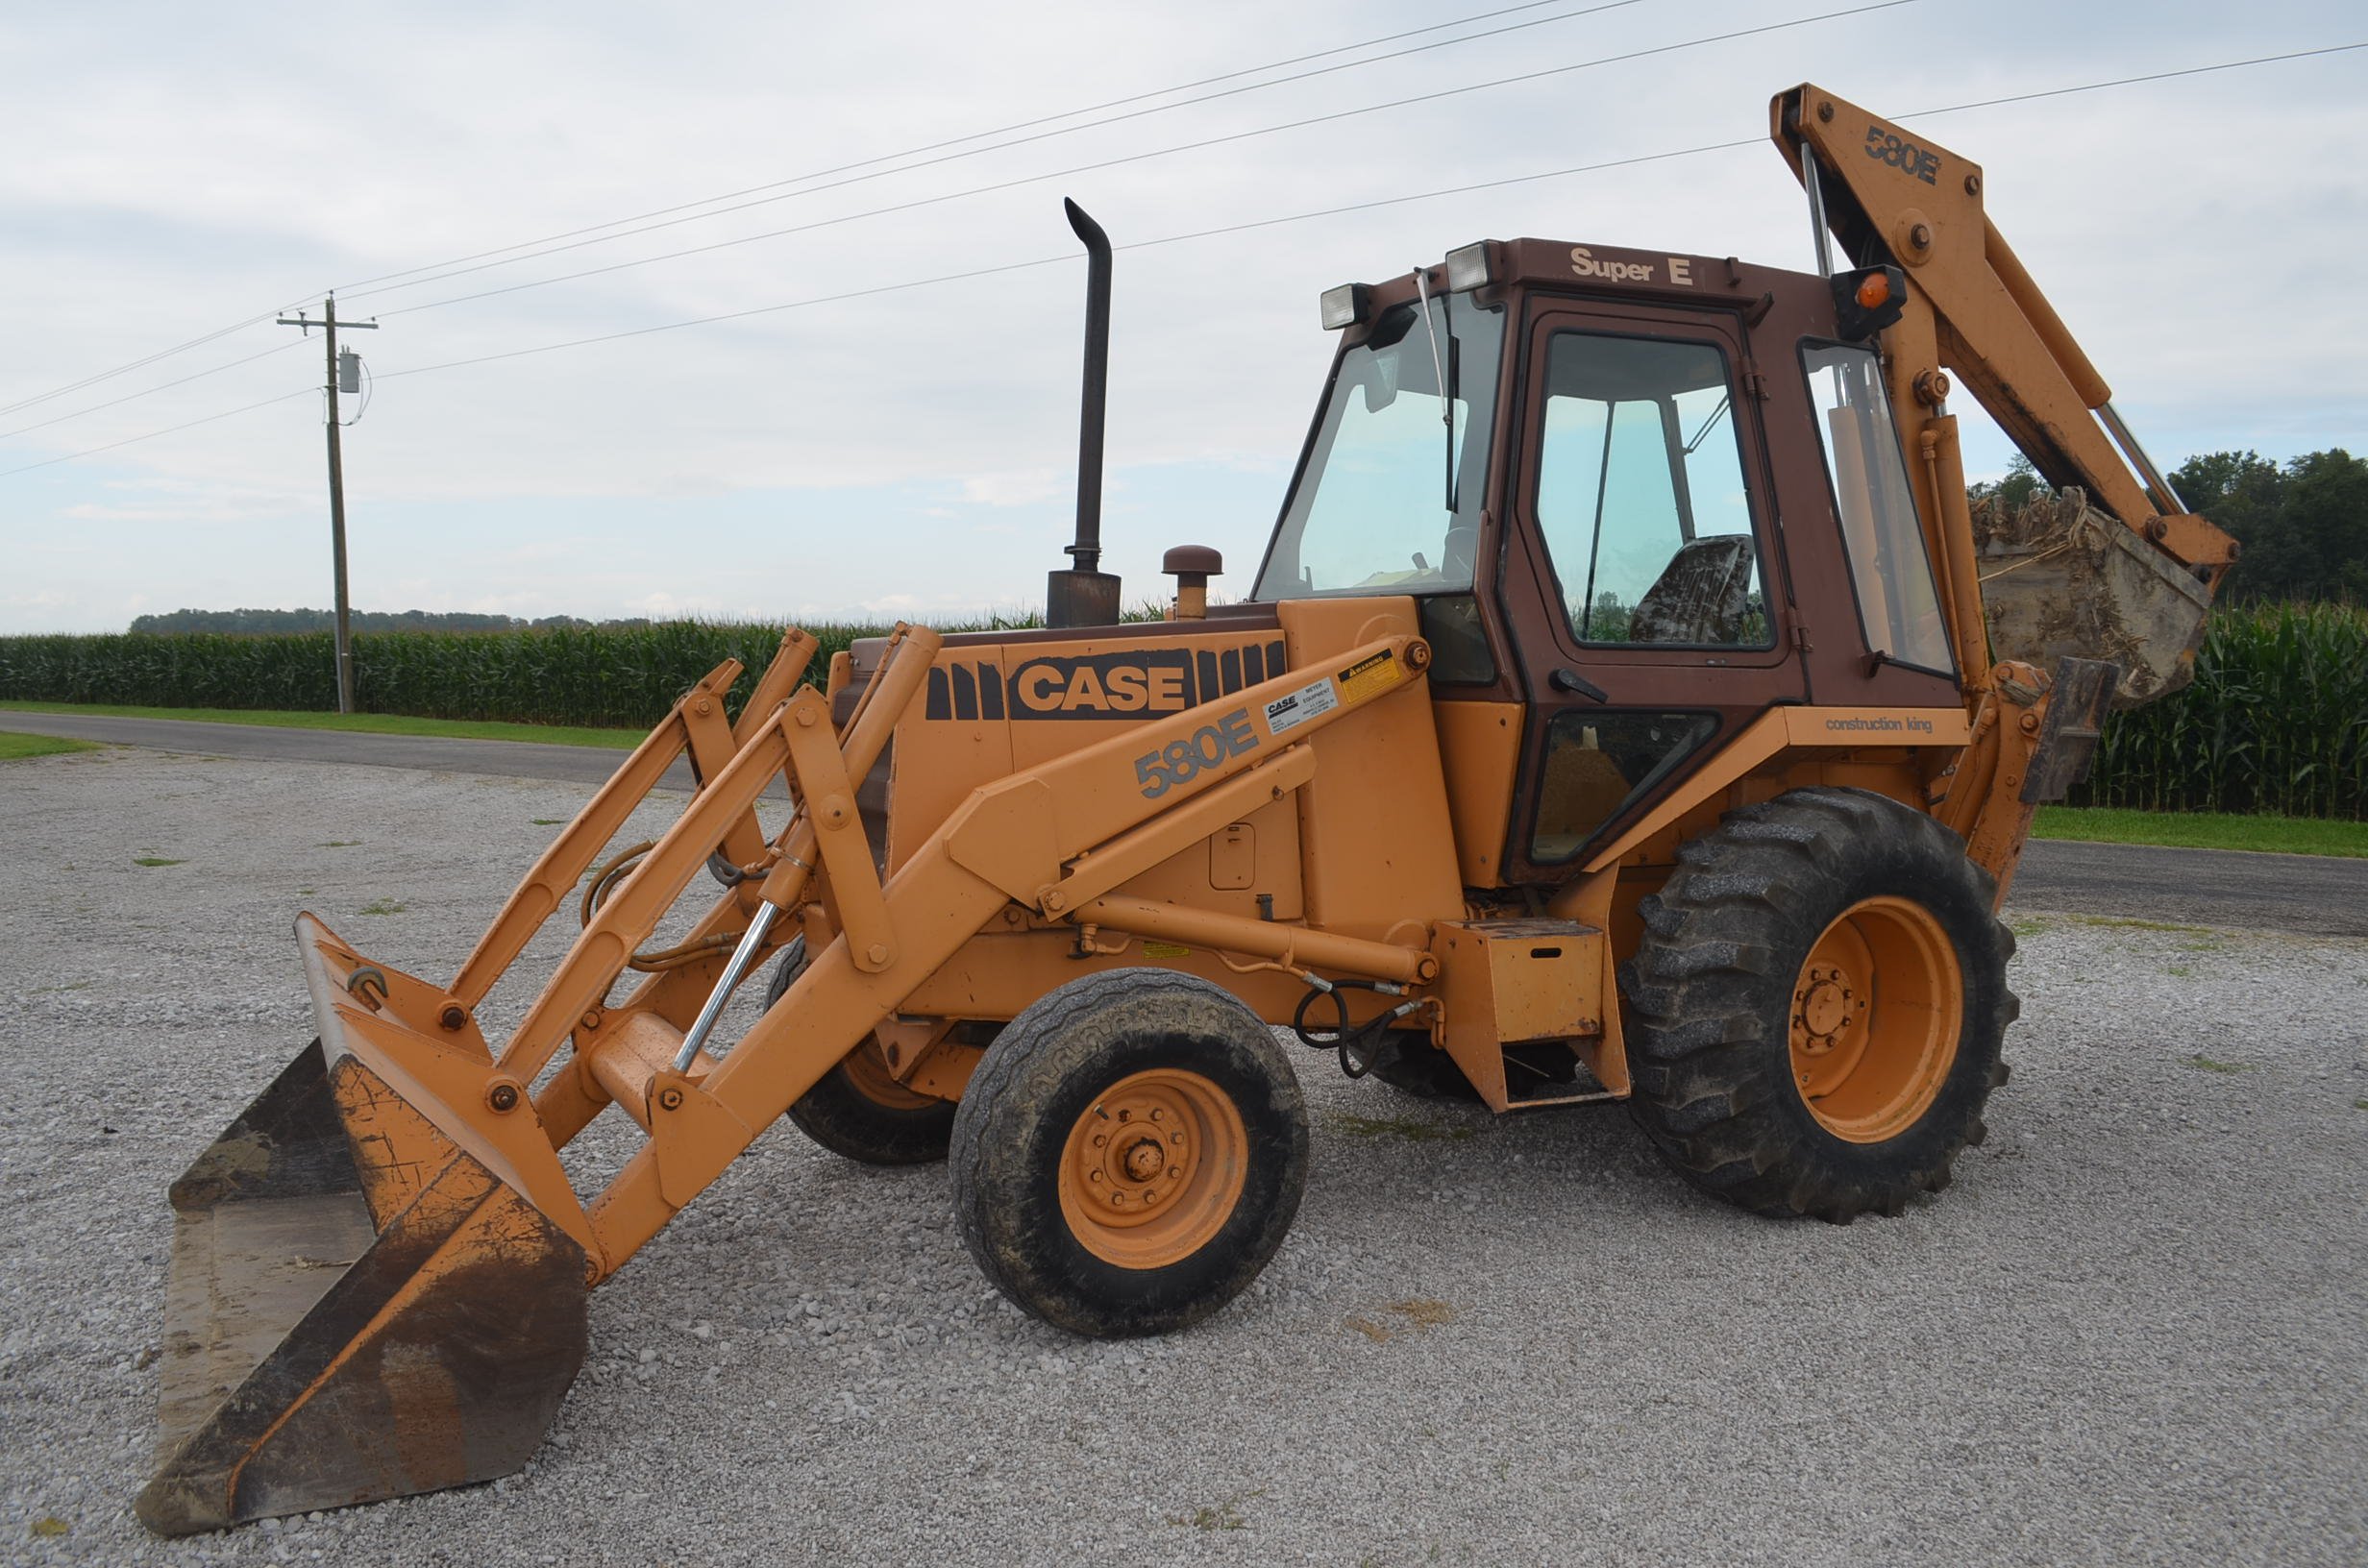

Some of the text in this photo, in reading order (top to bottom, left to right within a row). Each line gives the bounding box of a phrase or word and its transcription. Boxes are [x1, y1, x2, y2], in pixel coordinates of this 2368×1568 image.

[1864, 125, 1940, 185] 580E
[1570, 247, 1693, 286] Super E
[1356, 655, 1384, 673] WARNING
[1018, 664, 1185, 712] CASE
[1302, 688, 1330, 703] EQUIPMENT
[1305, 683, 1323, 694] MEYER
[1268, 695, 1296, 714] CASE
[1825, 717, 1933, 734] construction king
[1133, 706, 1260, 799] 580E
